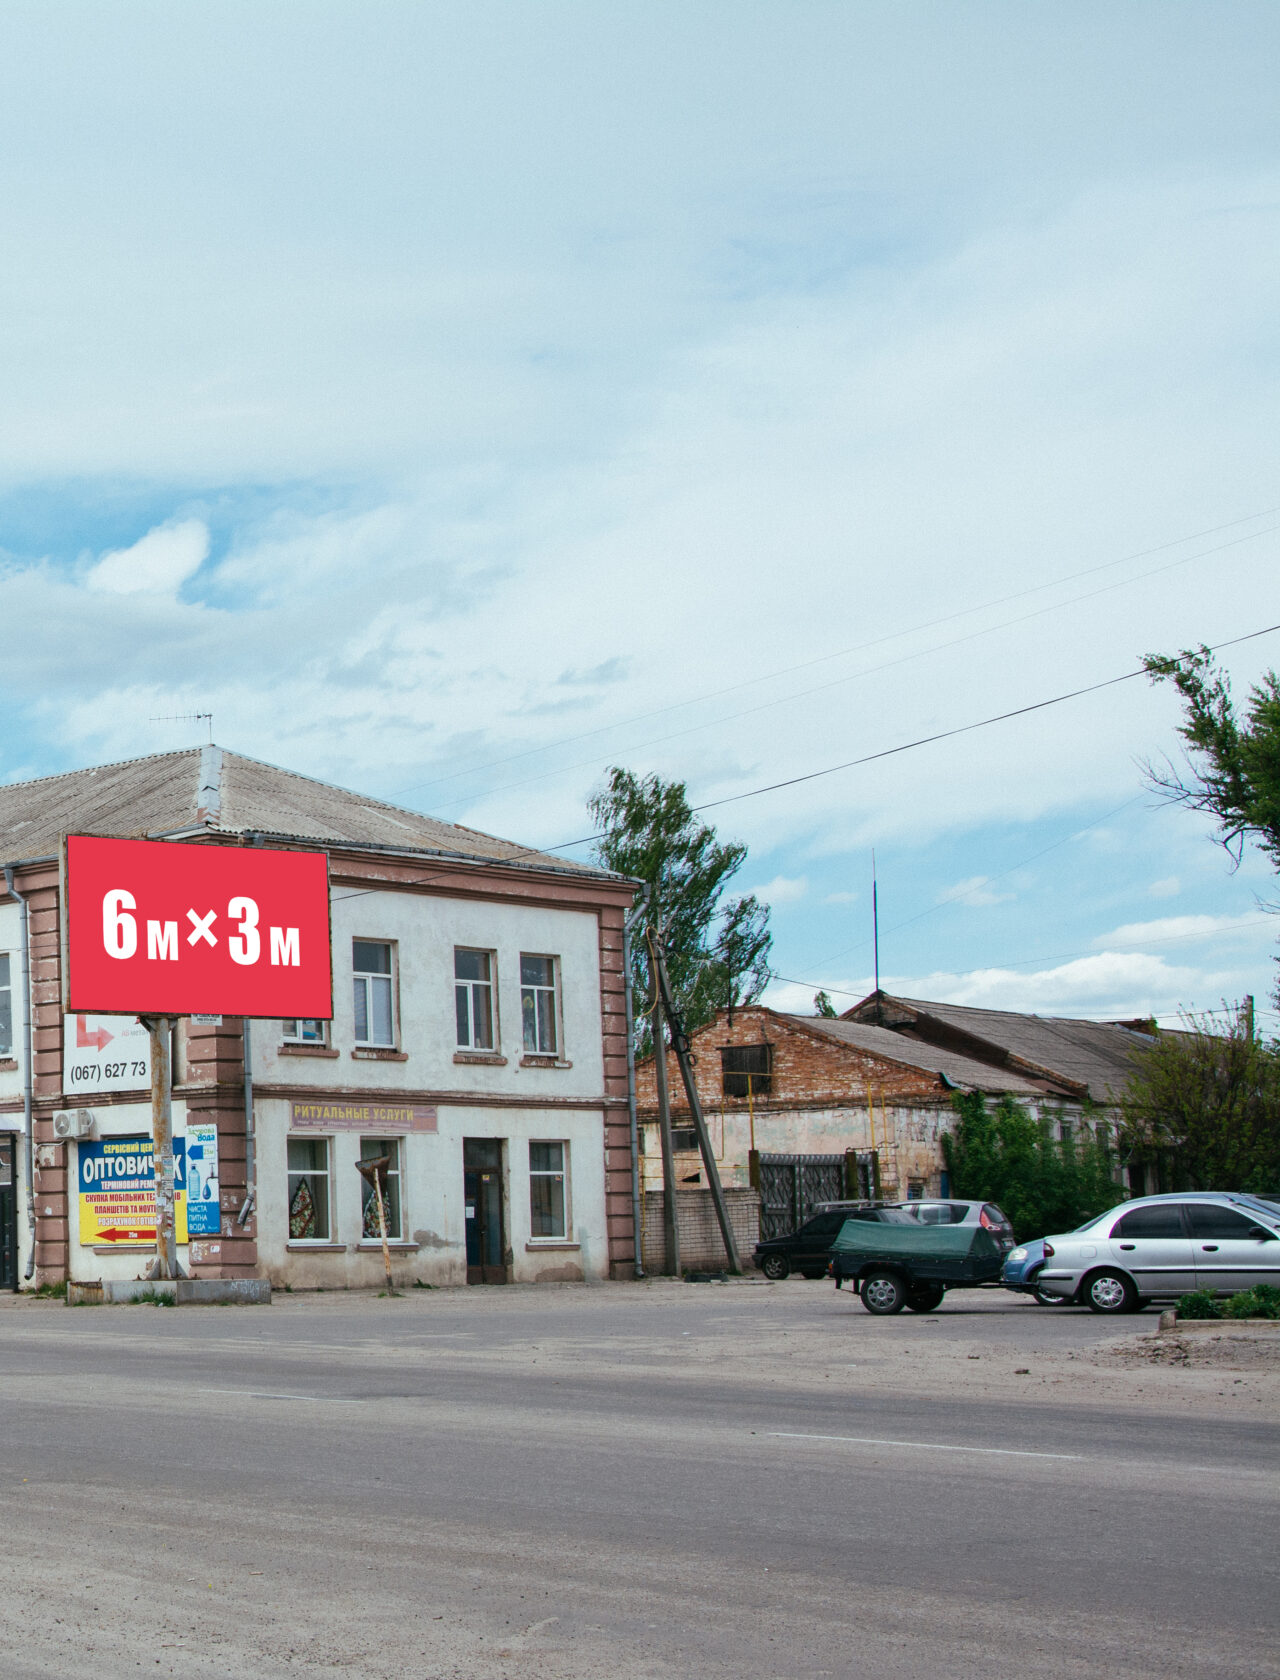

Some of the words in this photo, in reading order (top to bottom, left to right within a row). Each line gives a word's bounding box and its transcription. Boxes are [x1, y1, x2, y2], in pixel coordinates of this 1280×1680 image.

[70, 1063, 101, 1084] (067)
[104, 1062, 127, 1079] 627
[131, 1061, 146, 1076] 73
[293, 1104, 370, 1120] РИТУАЛЬНЫЕ
[372, 1107, 414, 1121] УСЛУГИ
[198, 1133, 215, 1142] Вода
[83, 1154, 182, 1184] ОПТОВИЧК
[85, 1194, 108, 1203] СКУПКА
[109, 1193, 145, 1202] МОБІЛЬНИХ
[94, 1205, 130, 1214] ПЛАНШЕТІВ
[130, 1205, 138, 1213] ТА
[188, 1205, 208, 1213] ЧИСТА
[189, 1223, 206, 1231] ВОДА
